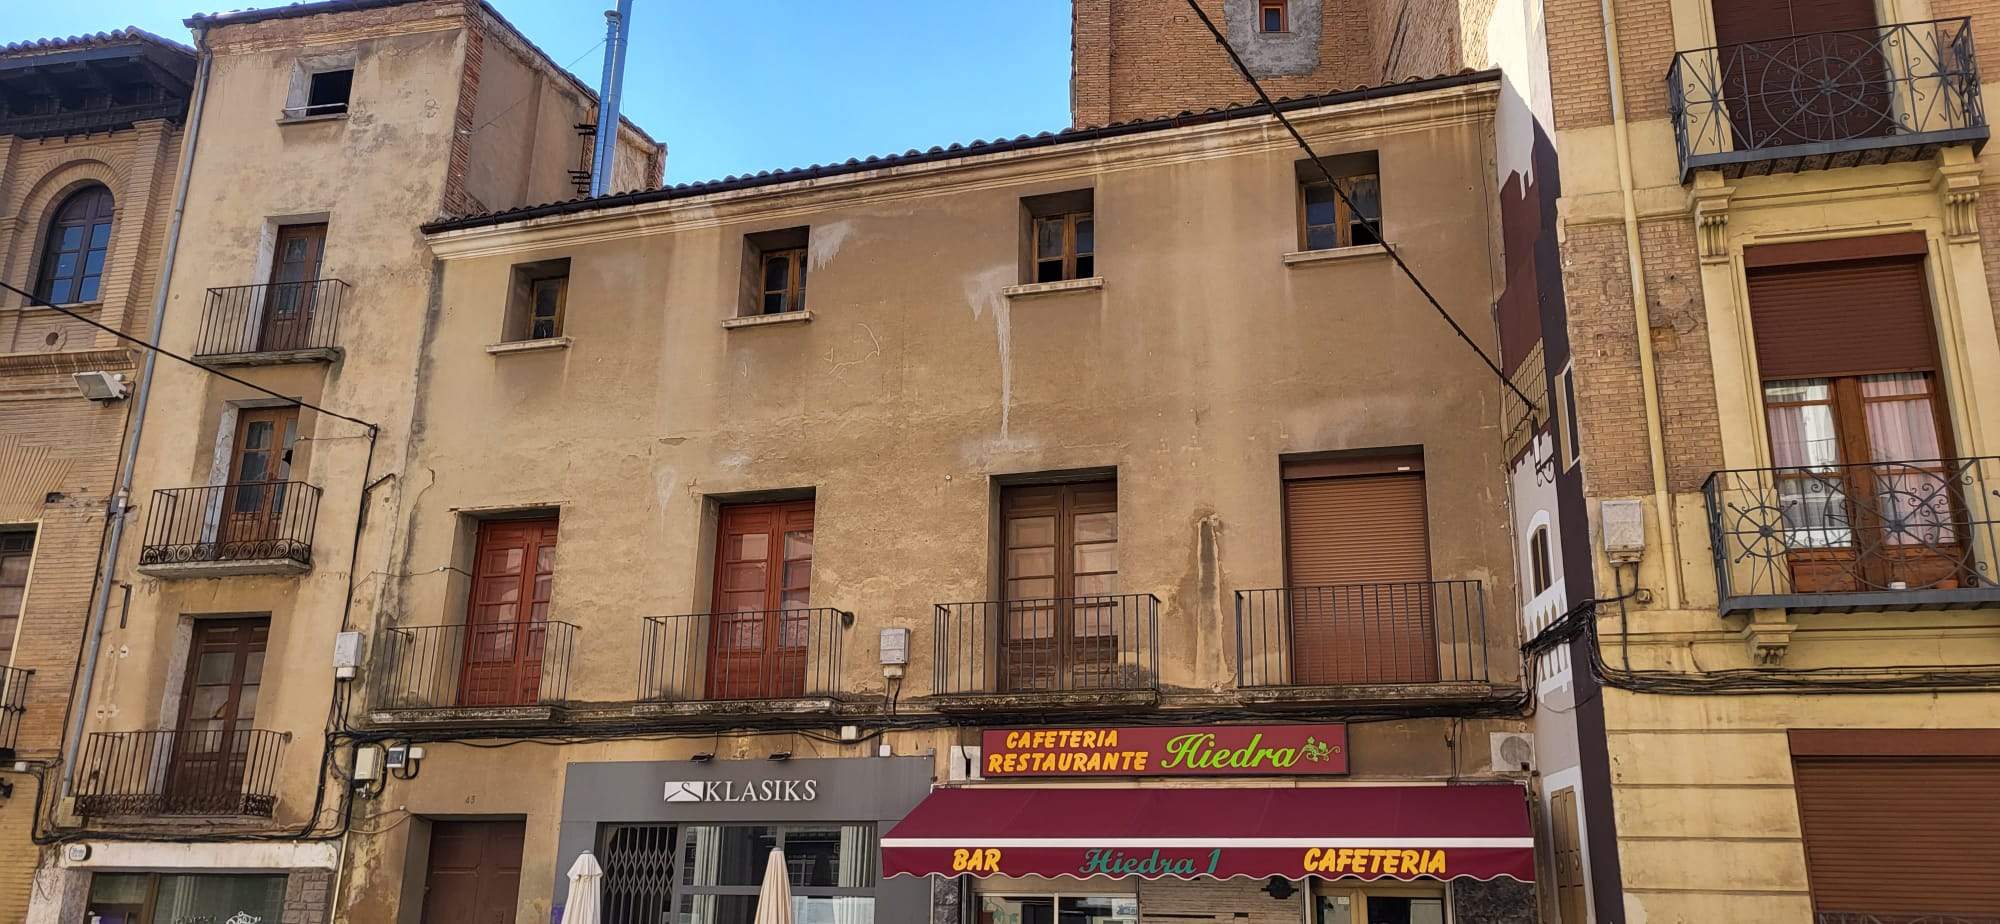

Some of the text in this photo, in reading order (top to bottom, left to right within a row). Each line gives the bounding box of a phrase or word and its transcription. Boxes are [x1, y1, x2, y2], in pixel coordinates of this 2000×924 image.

[1006, 730, 1118, 749] CAFETERIA
[1161, 733, 1296, 768] Hiedra
[988, 751, 1148, 773] RESTAURANTE
[704, 779, 817, 802] KLASIKS
[953, 848, 1001, 873] BAR
[1079, 848, 1221, 874] Hiedra 1
[1303, 847, 1446, 875] CAFETERIA
